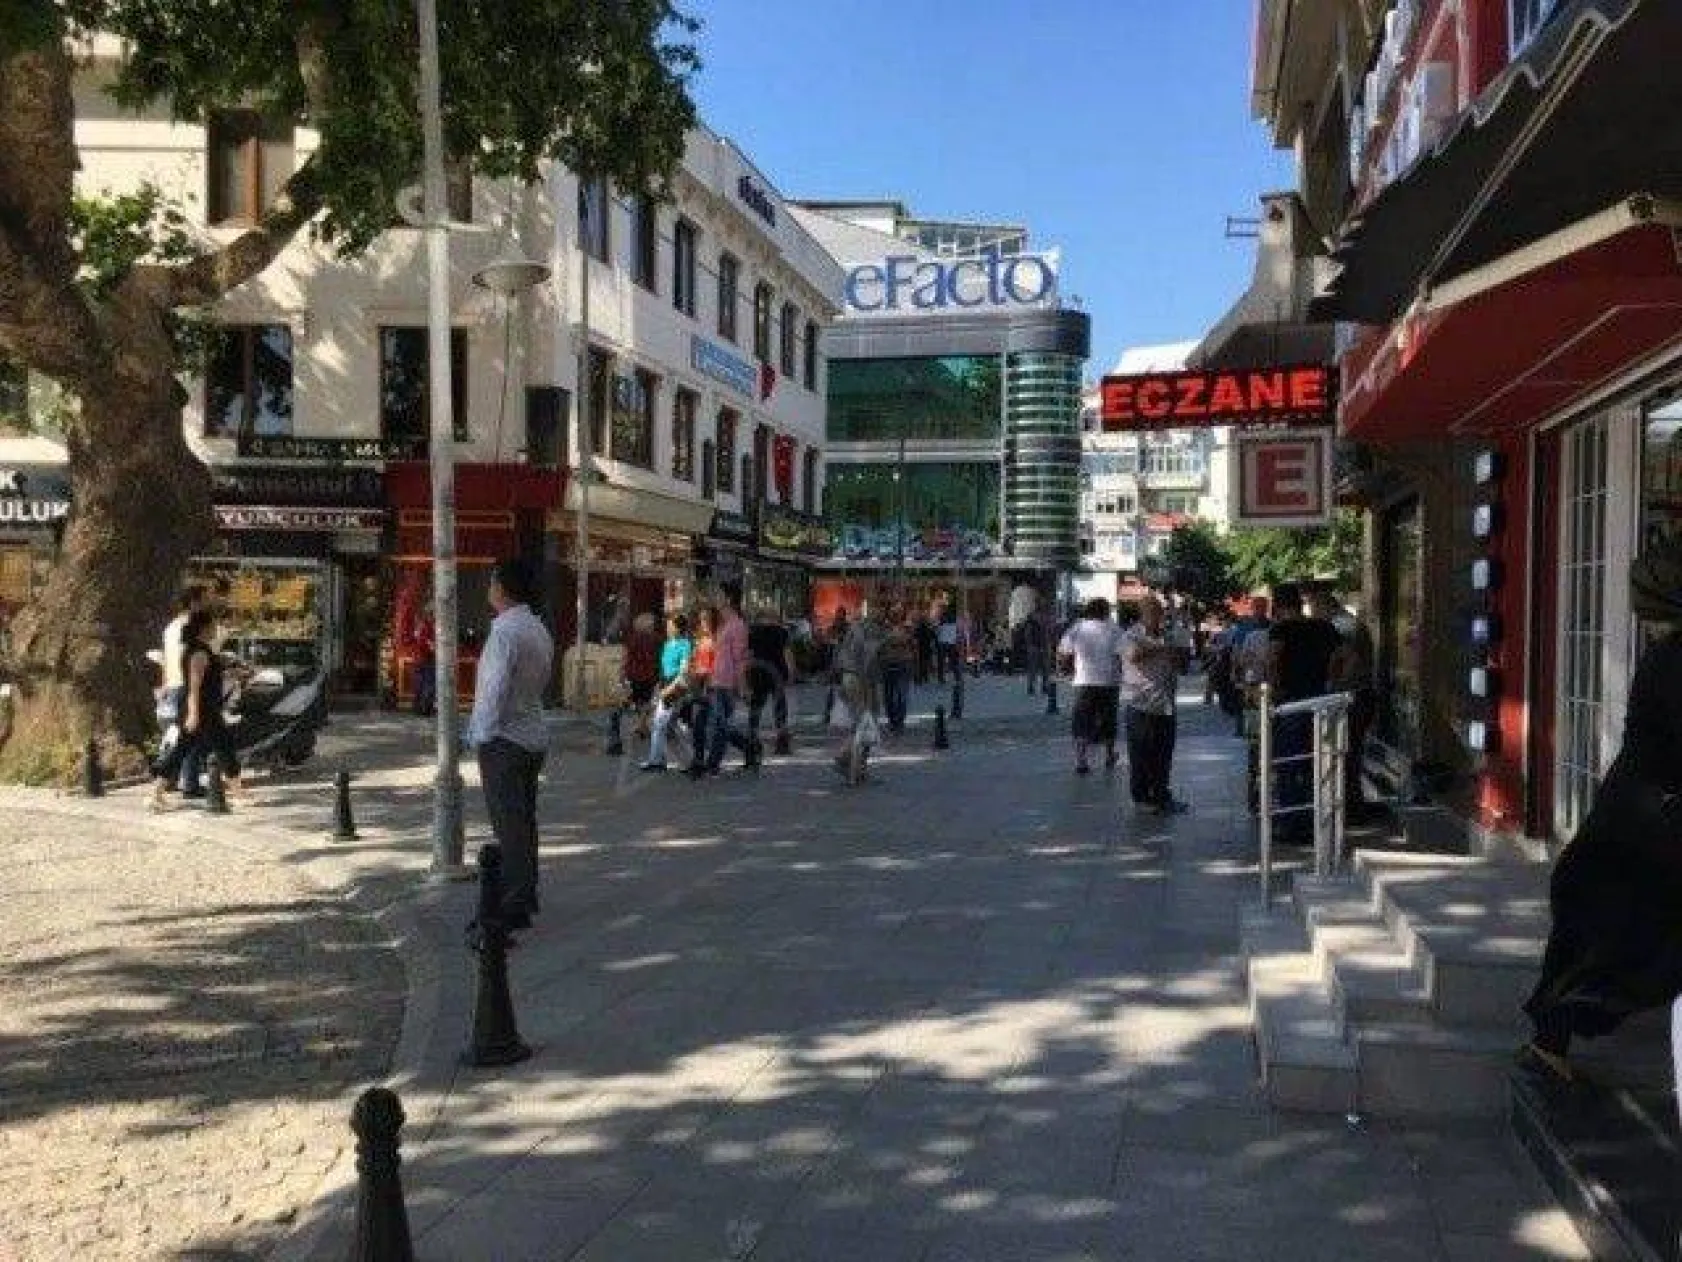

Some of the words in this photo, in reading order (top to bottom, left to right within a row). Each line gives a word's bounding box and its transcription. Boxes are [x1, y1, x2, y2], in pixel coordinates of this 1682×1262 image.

[844, 245, 1056, 310] eFacto
[1102, 367, 1326, 420] ECZANE
[1256, 444, 1309, 506] E
